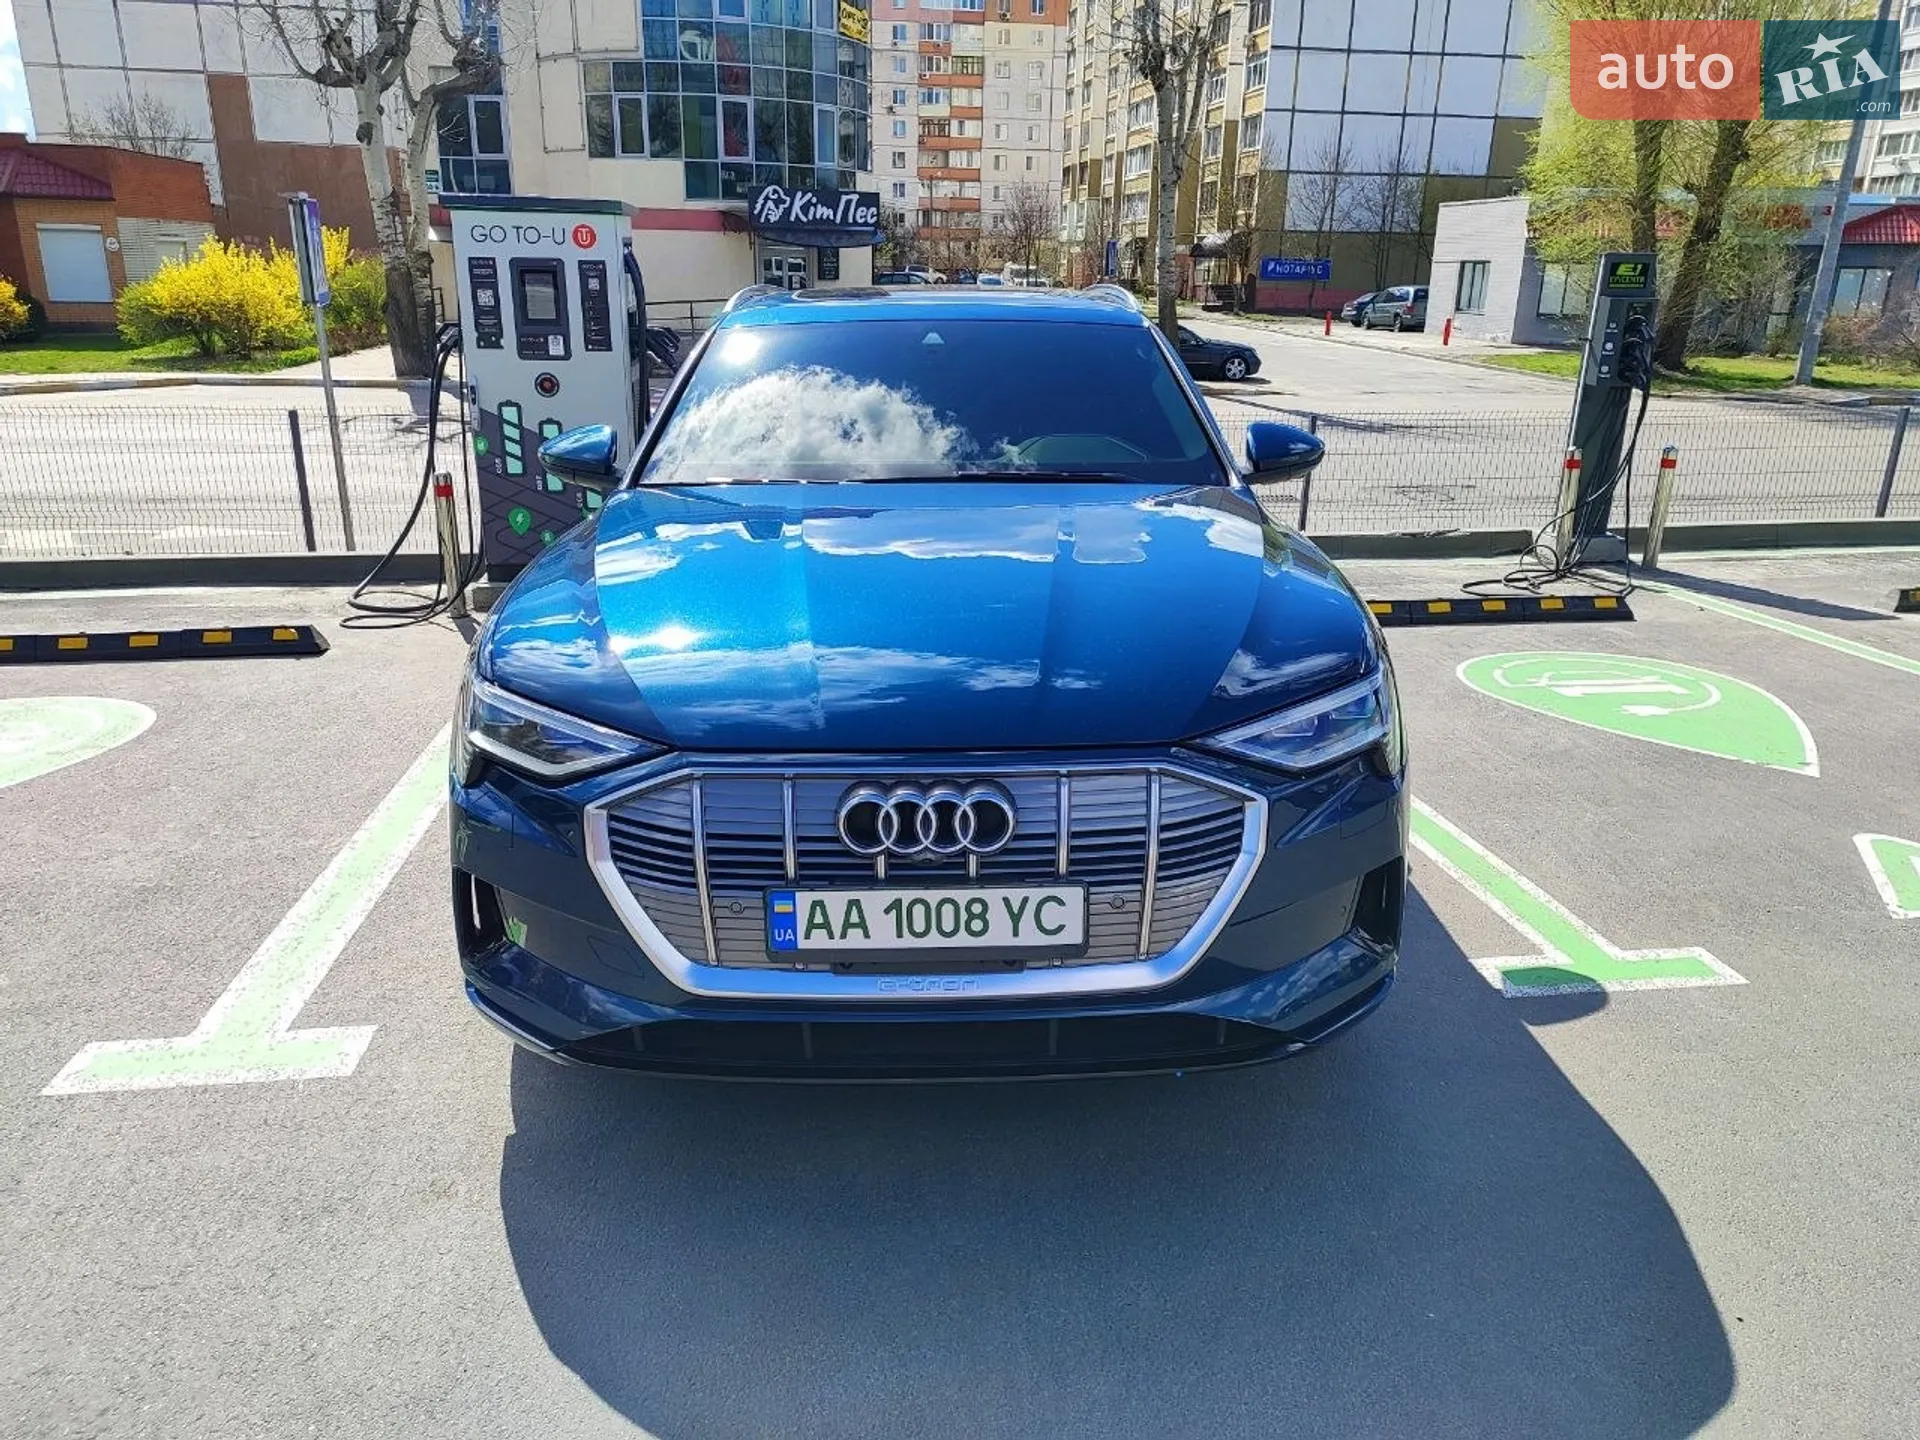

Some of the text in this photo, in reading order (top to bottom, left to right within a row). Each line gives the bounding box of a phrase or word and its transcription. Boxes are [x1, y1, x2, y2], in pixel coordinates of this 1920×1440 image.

[470, 225, 566, 245] GO TO-U
[803, 895, 1067, 940] AA 1008 YC
[774, 929, 795, 942] UA
